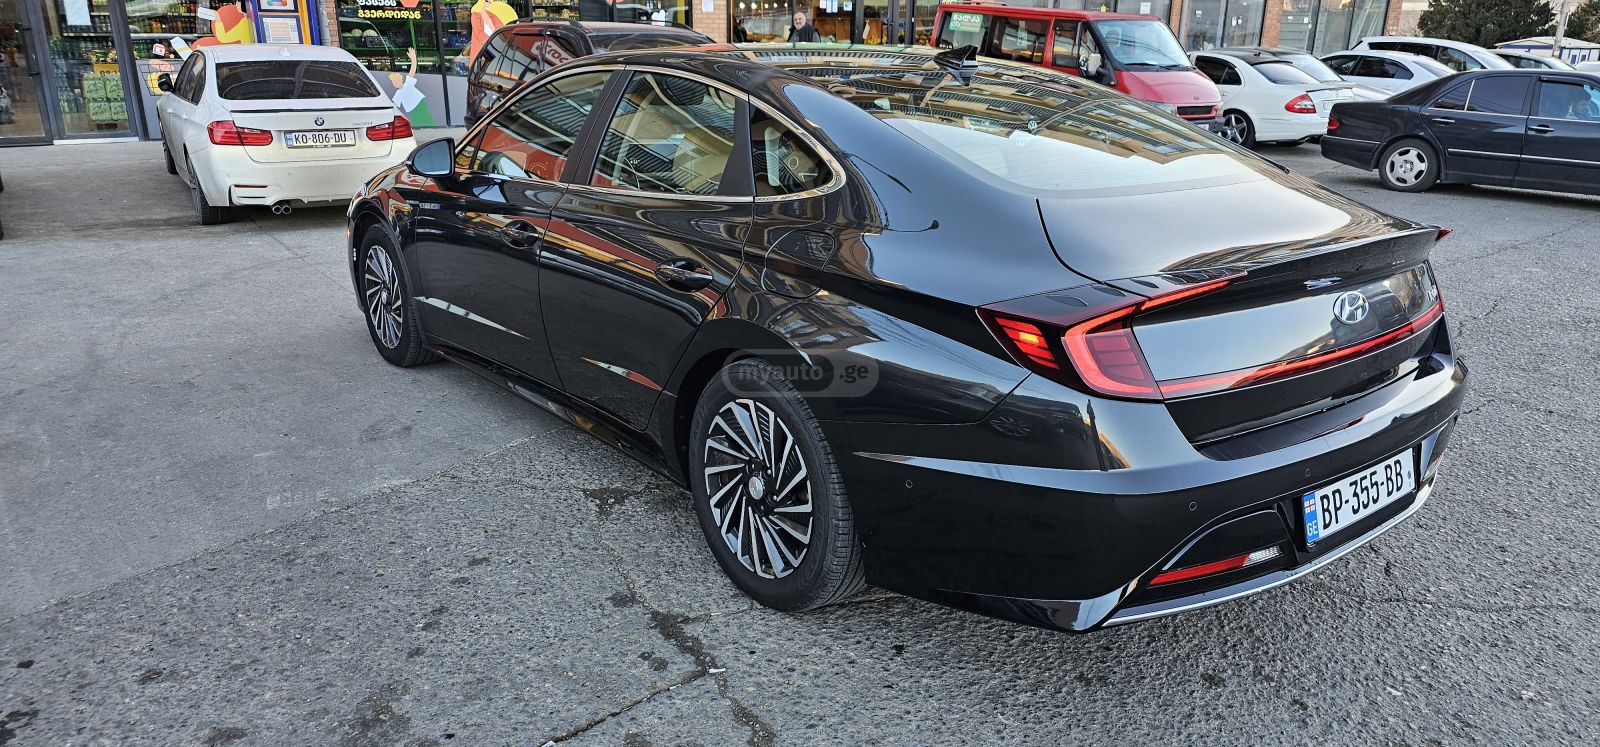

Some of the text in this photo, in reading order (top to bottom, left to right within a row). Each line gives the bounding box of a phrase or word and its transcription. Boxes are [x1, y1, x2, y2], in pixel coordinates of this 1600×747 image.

[357, 9, 421, 19] გვერდიდან
[294, 132, 347, 144] KO-806-DU
[1319, 459, 1404, 531] BP-355-BB
[1307, 519, 1319, 536] GE
